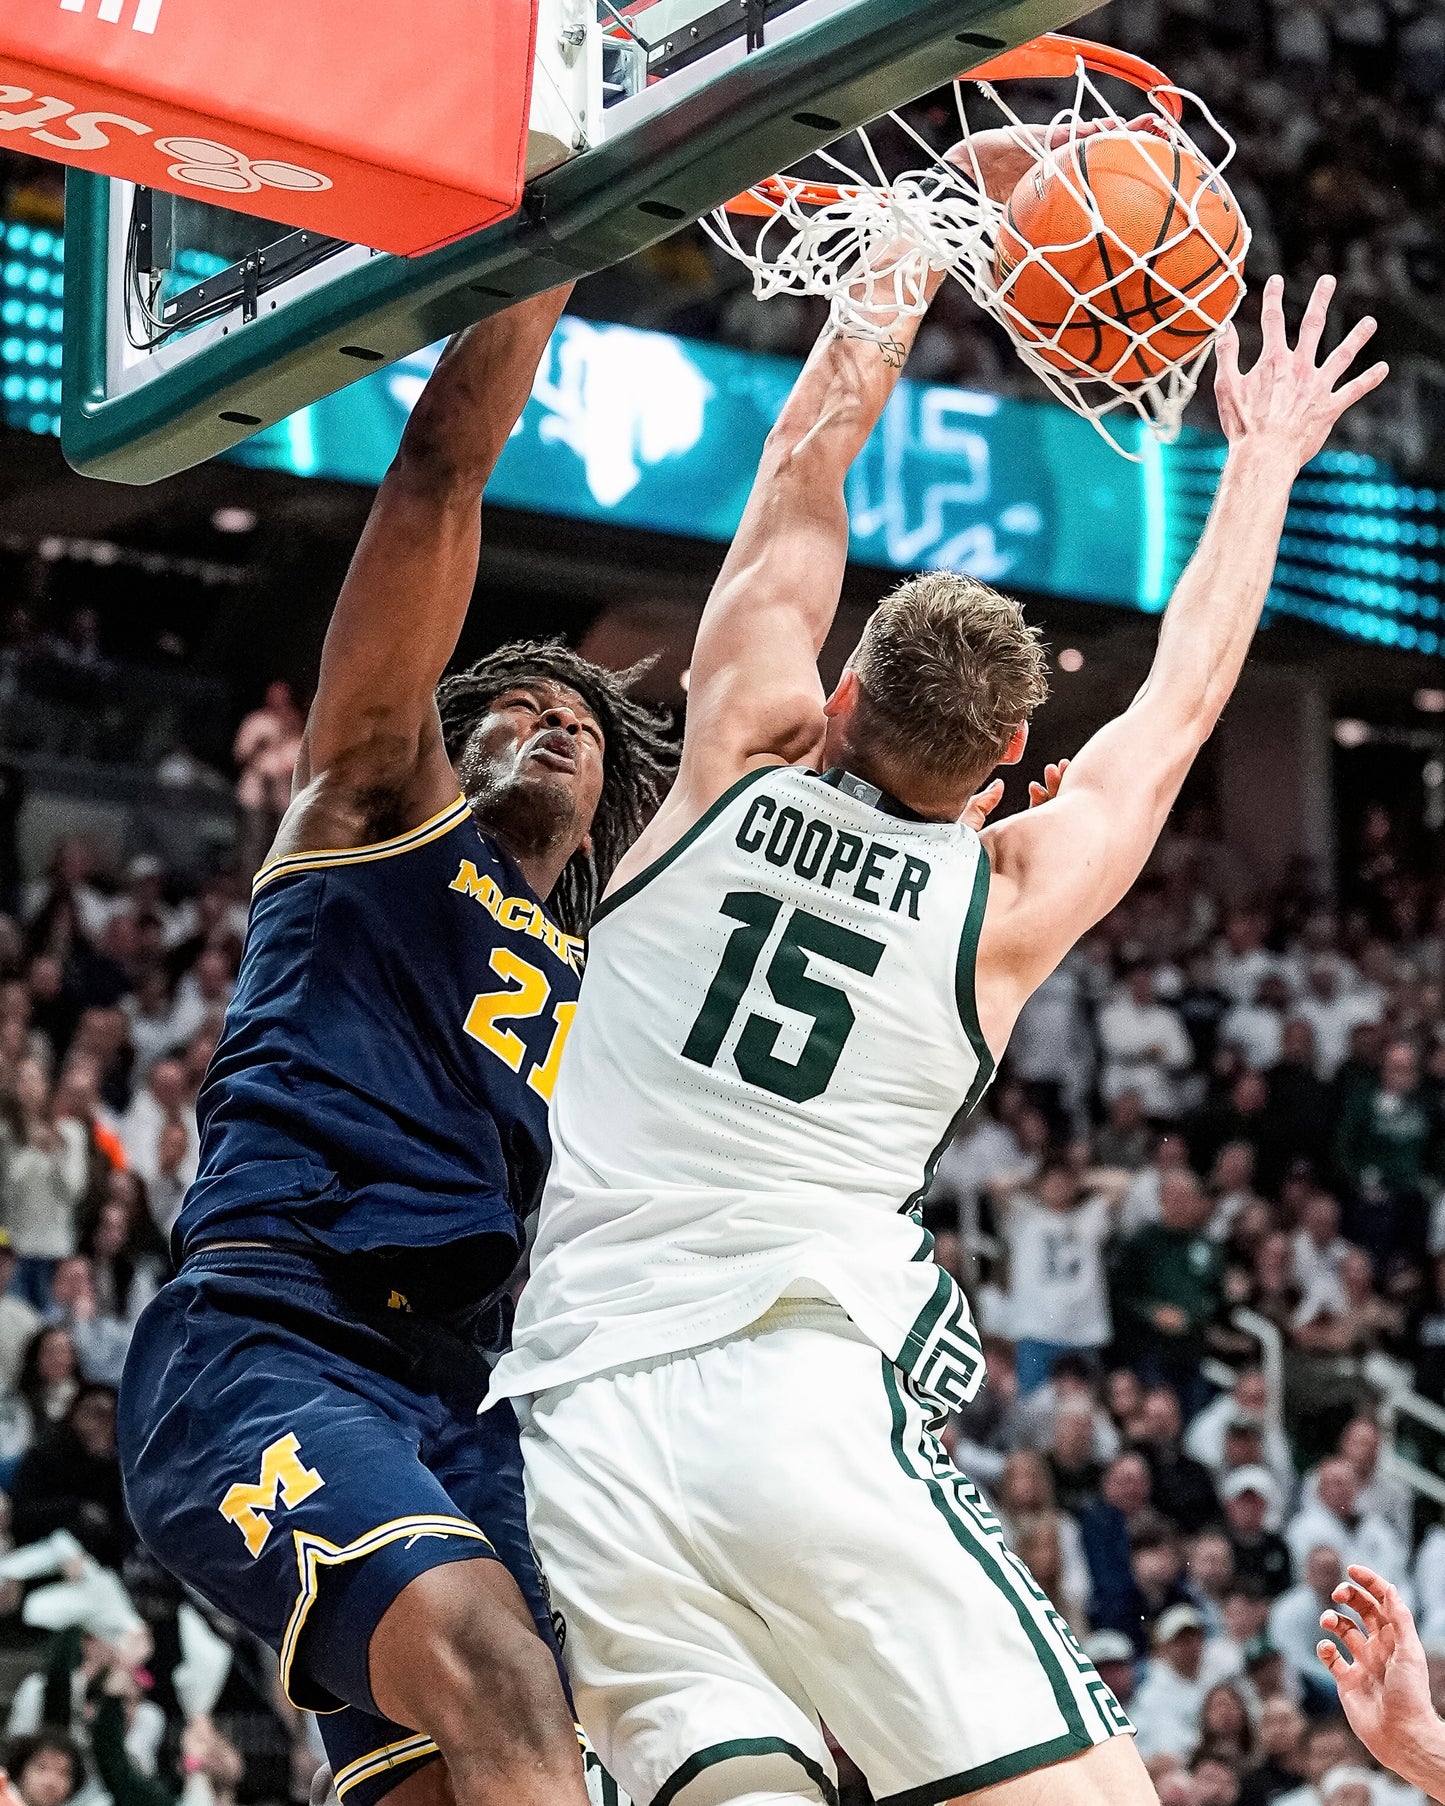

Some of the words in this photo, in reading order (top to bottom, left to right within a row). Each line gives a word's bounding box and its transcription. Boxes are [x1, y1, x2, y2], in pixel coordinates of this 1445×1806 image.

[449, 859, 581, 980] MICHI
[735, 794, 931, 921] COOPER
[463, 948, 578, 1106] 21
[680, 891, 887, 1104] 15
[218, 1432, 326, 1559] M
